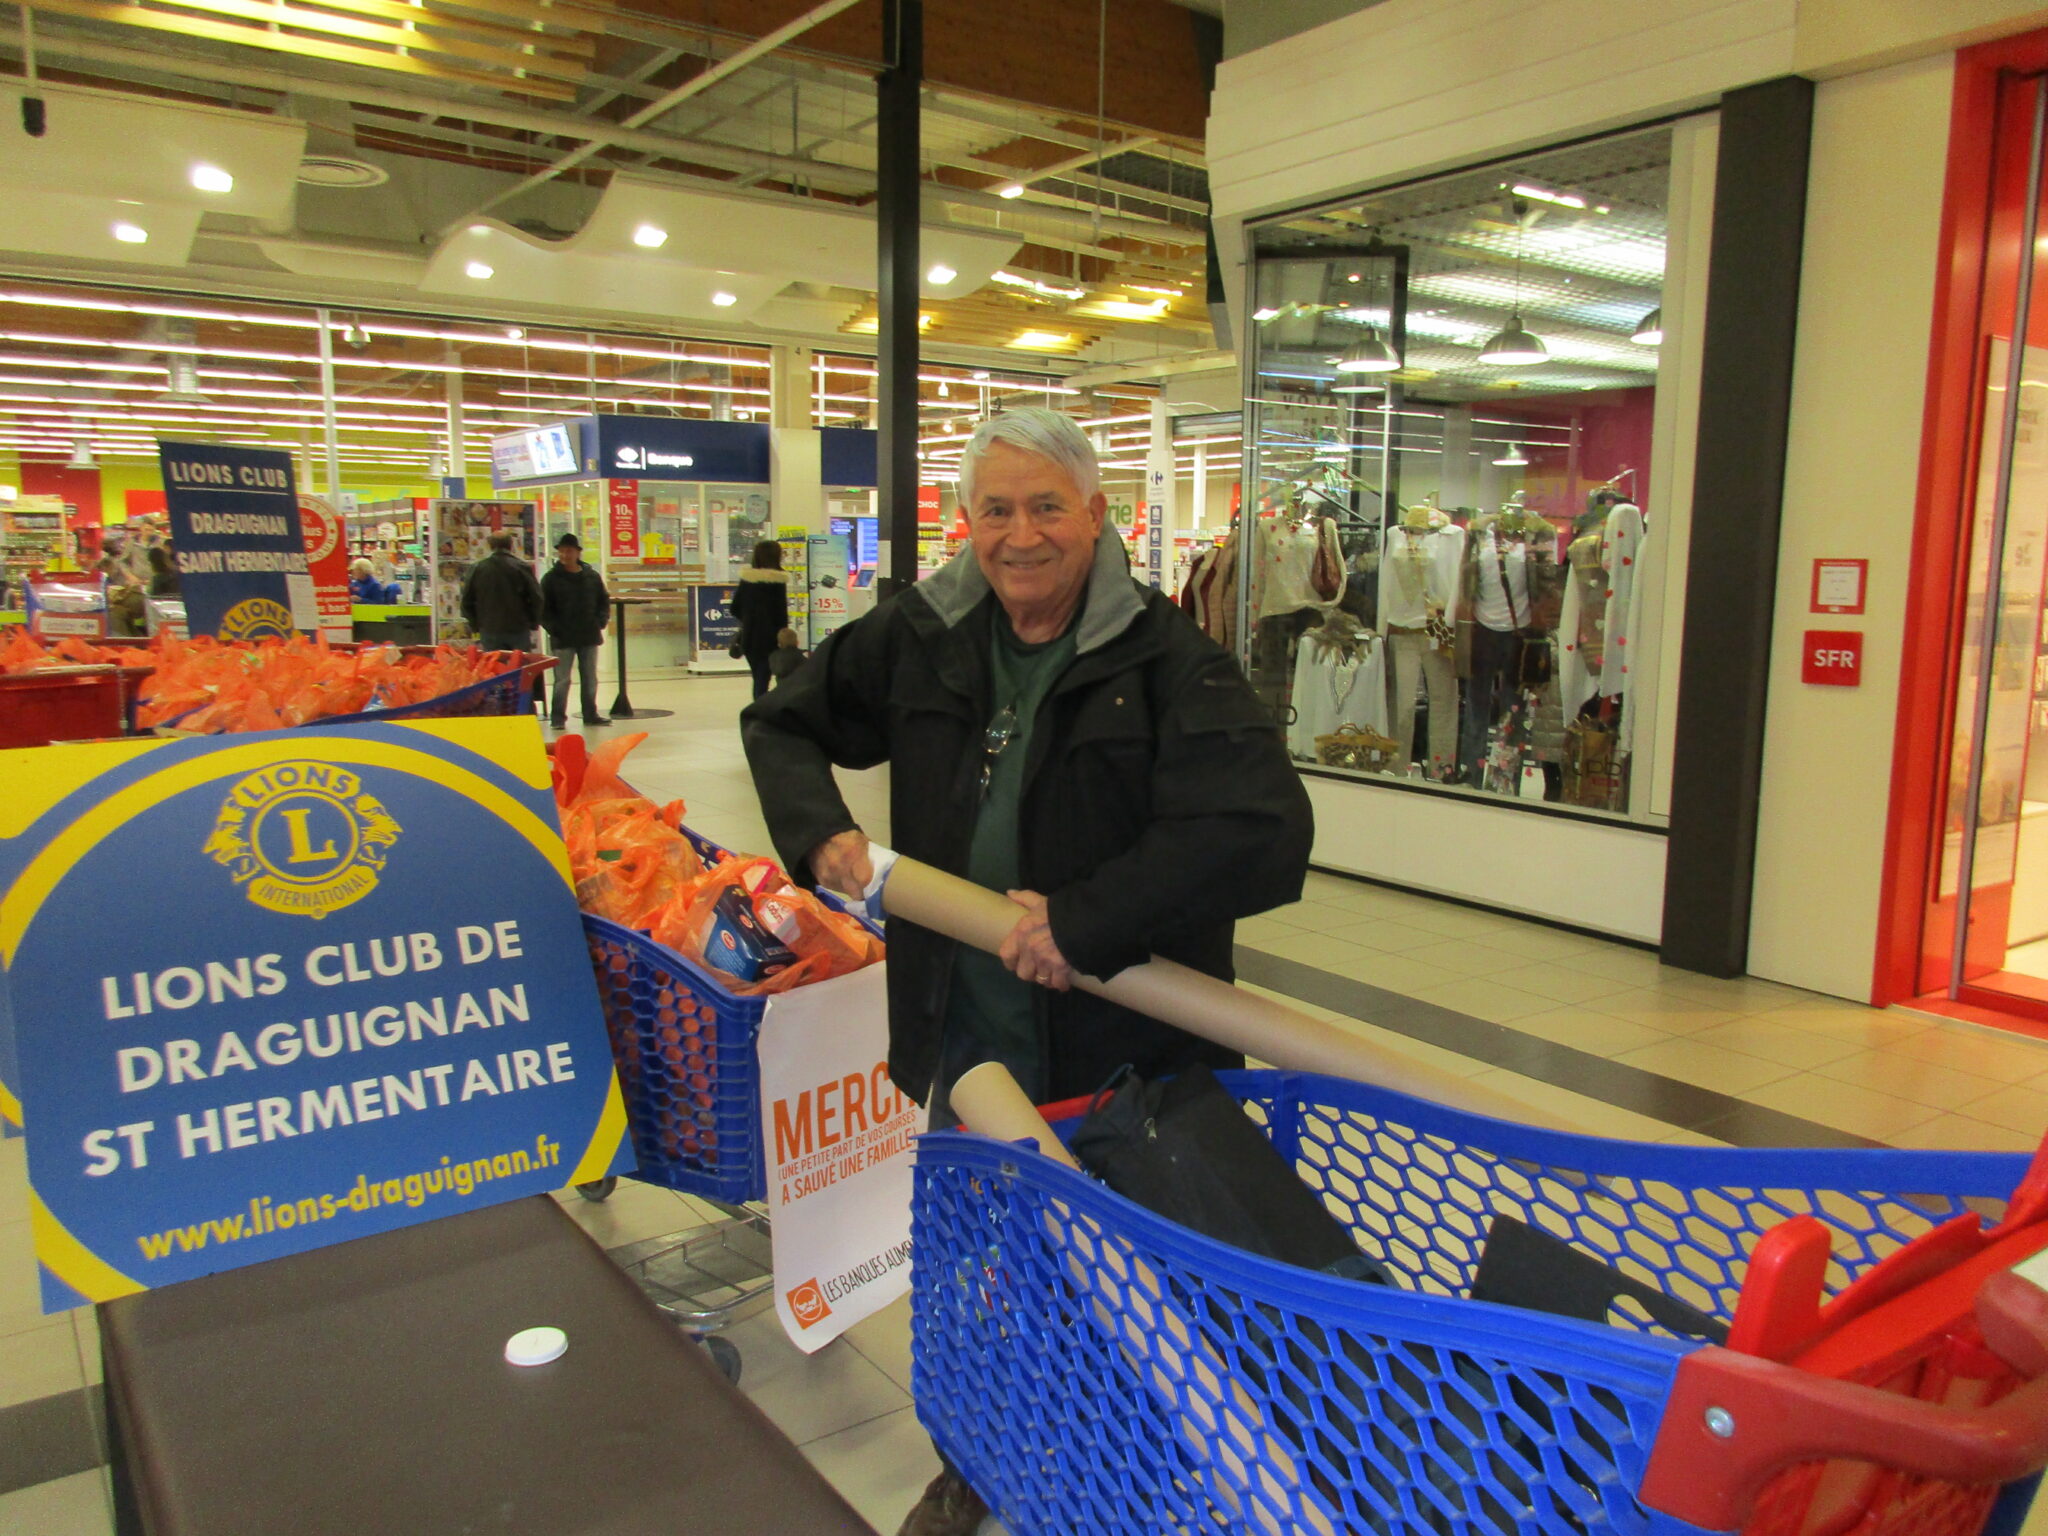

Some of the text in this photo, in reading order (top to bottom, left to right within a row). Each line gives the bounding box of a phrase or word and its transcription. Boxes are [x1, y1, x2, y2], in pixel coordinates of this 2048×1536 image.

[170, 461, 288, 488] LIONS CLUB
[190, 511, 288, 536] DRAGUIGNAN
[177, 551, 224, 574] SAINT
[230, 600, 290, 625] LIONS
[1814, 649, 1855, 669] SFR
[241, 766, 353, 802] LIONS
[281, 808, 339, 863] L
[258, 873, 370, 908] INTERNATIONAL
[102, 920, 523, 1020] LIONS CLUB DE
[117, 984, 530, 1093] DRAGUIGNAN
[82, 1042, 576, 1177] ST HERMENTAIRE
[801, 1152, 831, 1173] PETITE
[831, 1139, 854, 1163] PART
[856, 1135, 866, 1150] DE
[868, 1127, 883, 1144] VOS
[884, 1110, 916, 1135] COURSES
[138, 1134, 560, 1261] www.lions-draguignan.fr
[782, 1184, 790, 1206] A
[794, 1162, 837, 1199] SAUVÉ
[839, 1151, 864, 1179] UNE
[822, 1278, 844, 1303] LES
[839, 1255, 887, 1294] BANQUES
